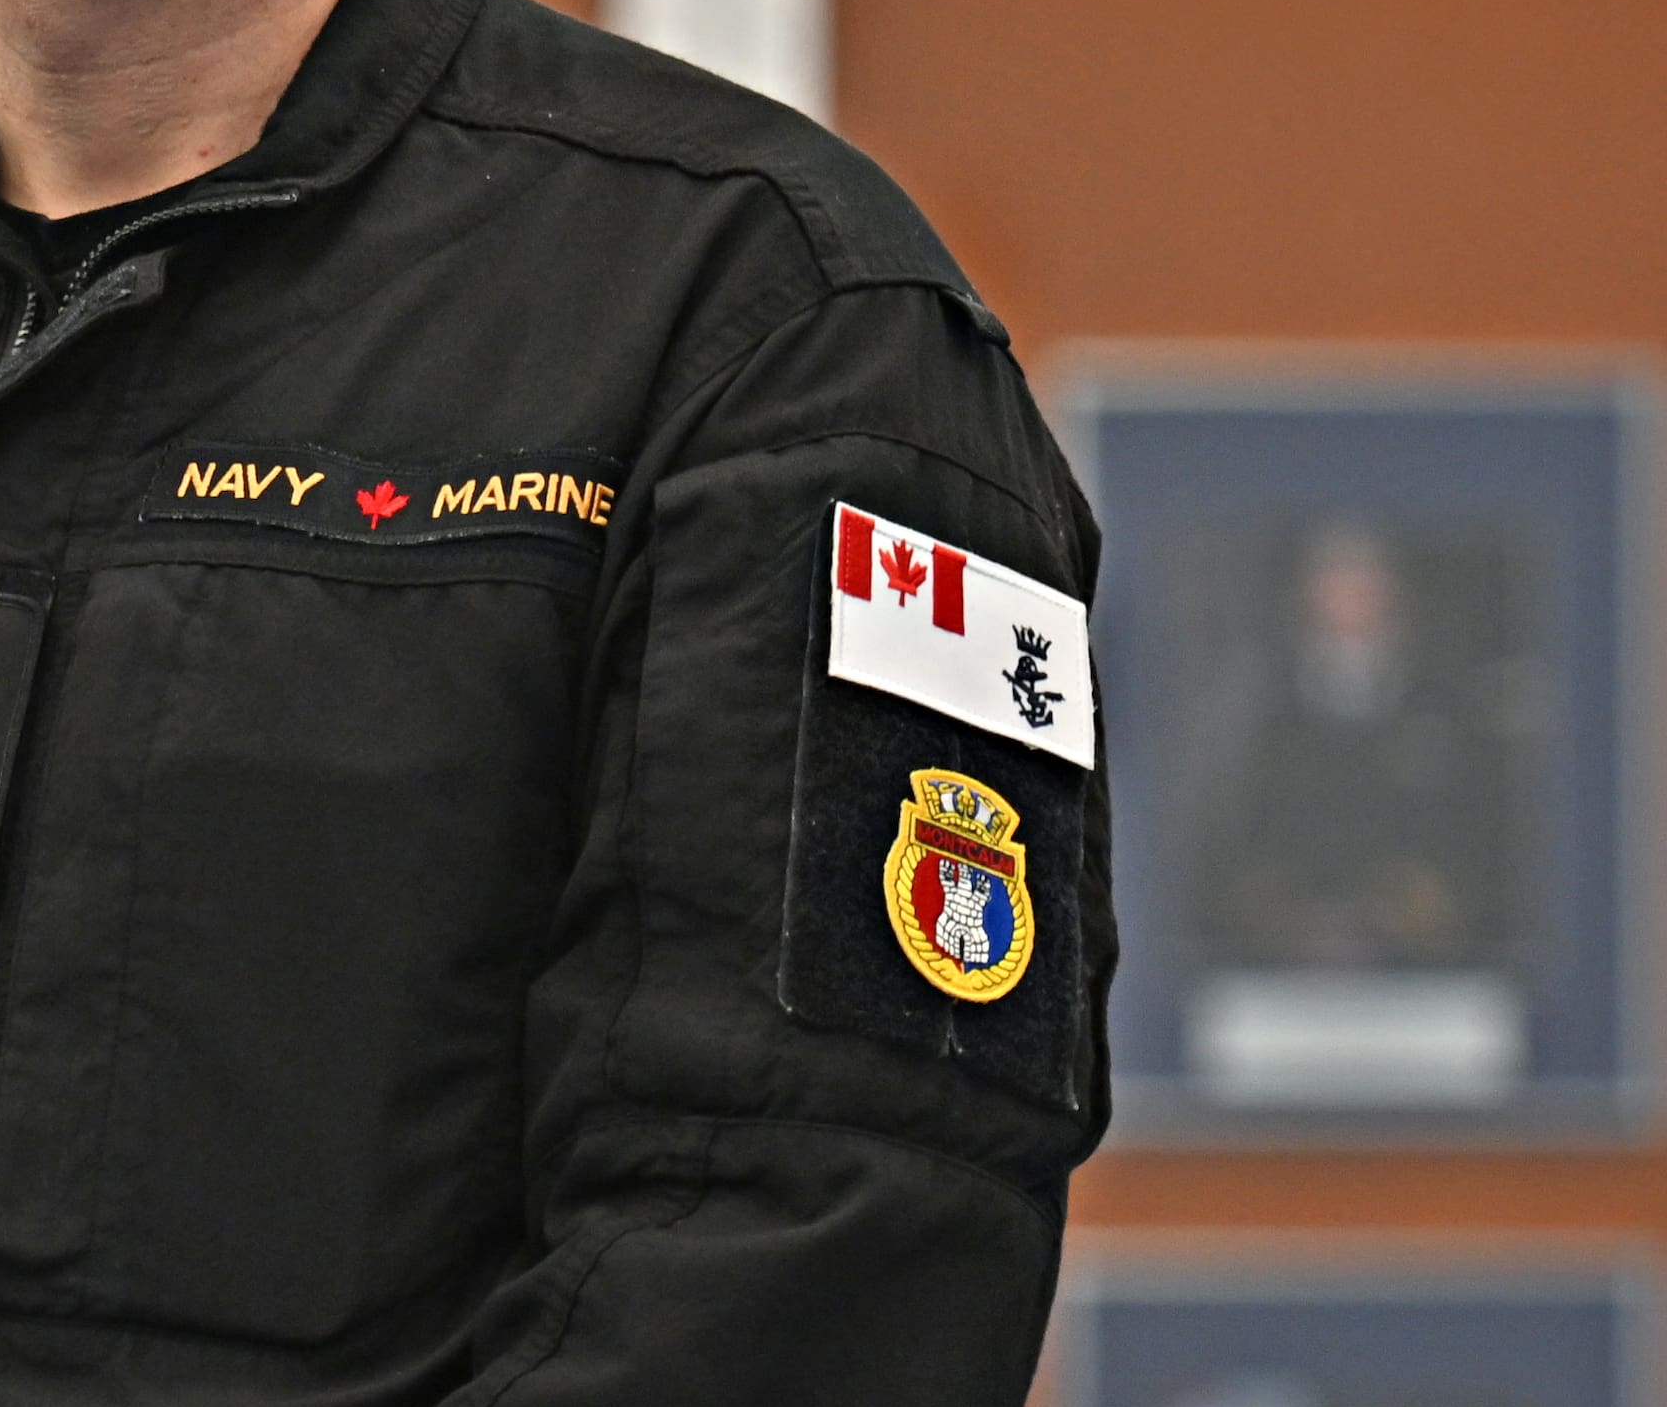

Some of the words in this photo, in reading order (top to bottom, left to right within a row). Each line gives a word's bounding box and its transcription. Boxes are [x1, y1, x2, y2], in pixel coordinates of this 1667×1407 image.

[177, 461, 326, 507] NAVY
[432, 471, 616, 527] MARINE
[914, 818, 1016, 879] MONTCALM
